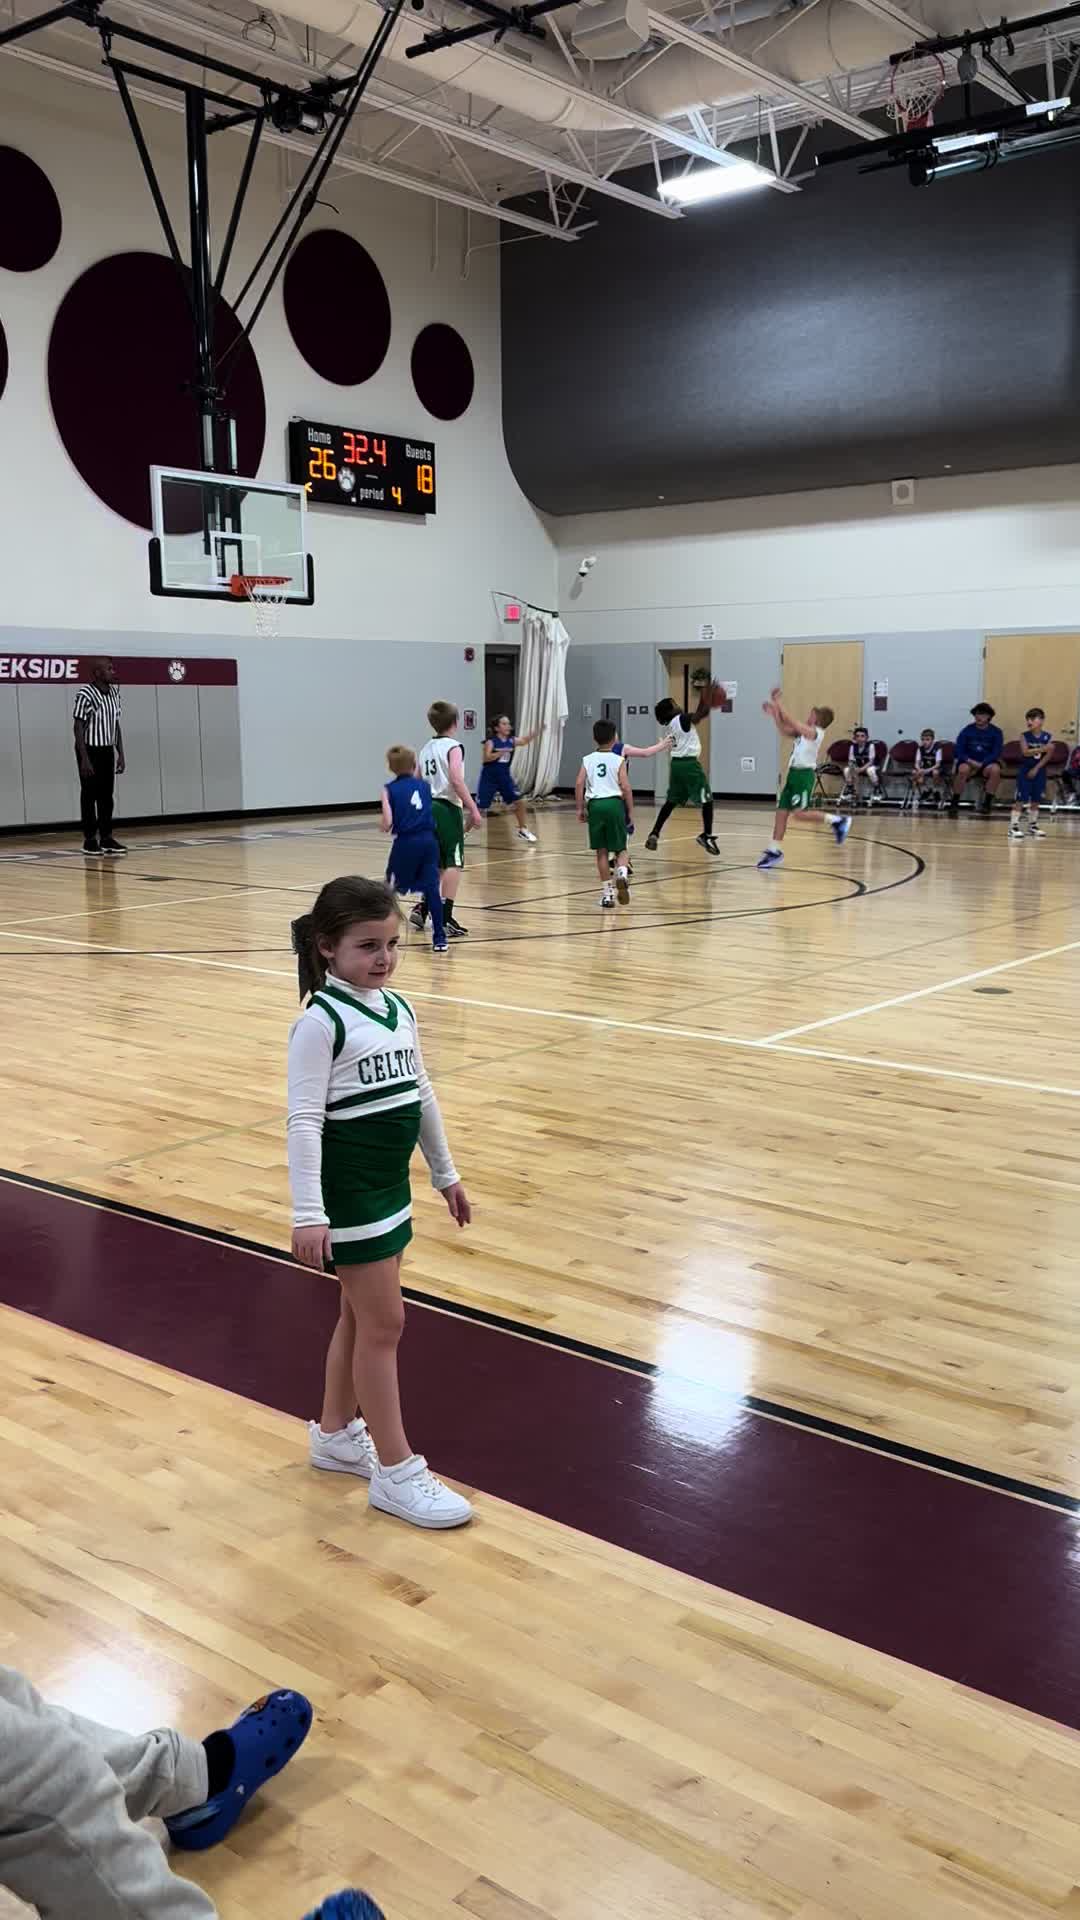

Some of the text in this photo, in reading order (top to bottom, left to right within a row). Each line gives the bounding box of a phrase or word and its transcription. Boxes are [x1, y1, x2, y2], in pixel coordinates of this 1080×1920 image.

[308, 427, 332, 444] Home
[343, 432, 387, 467] 32.4
[405, 443, 432, 461] Guests
[309, 447, 336, 480] 26
[417, 464, 433, 494] 18
[360, 487, 384, 501] period
[392, 486, 402, 505] 4
[0, 658, 79, 679] EKSIDE
[425, 759, 438, 777] 13
[597, 763, 607, 778] 3
[410, 790, 423, 810] 4
